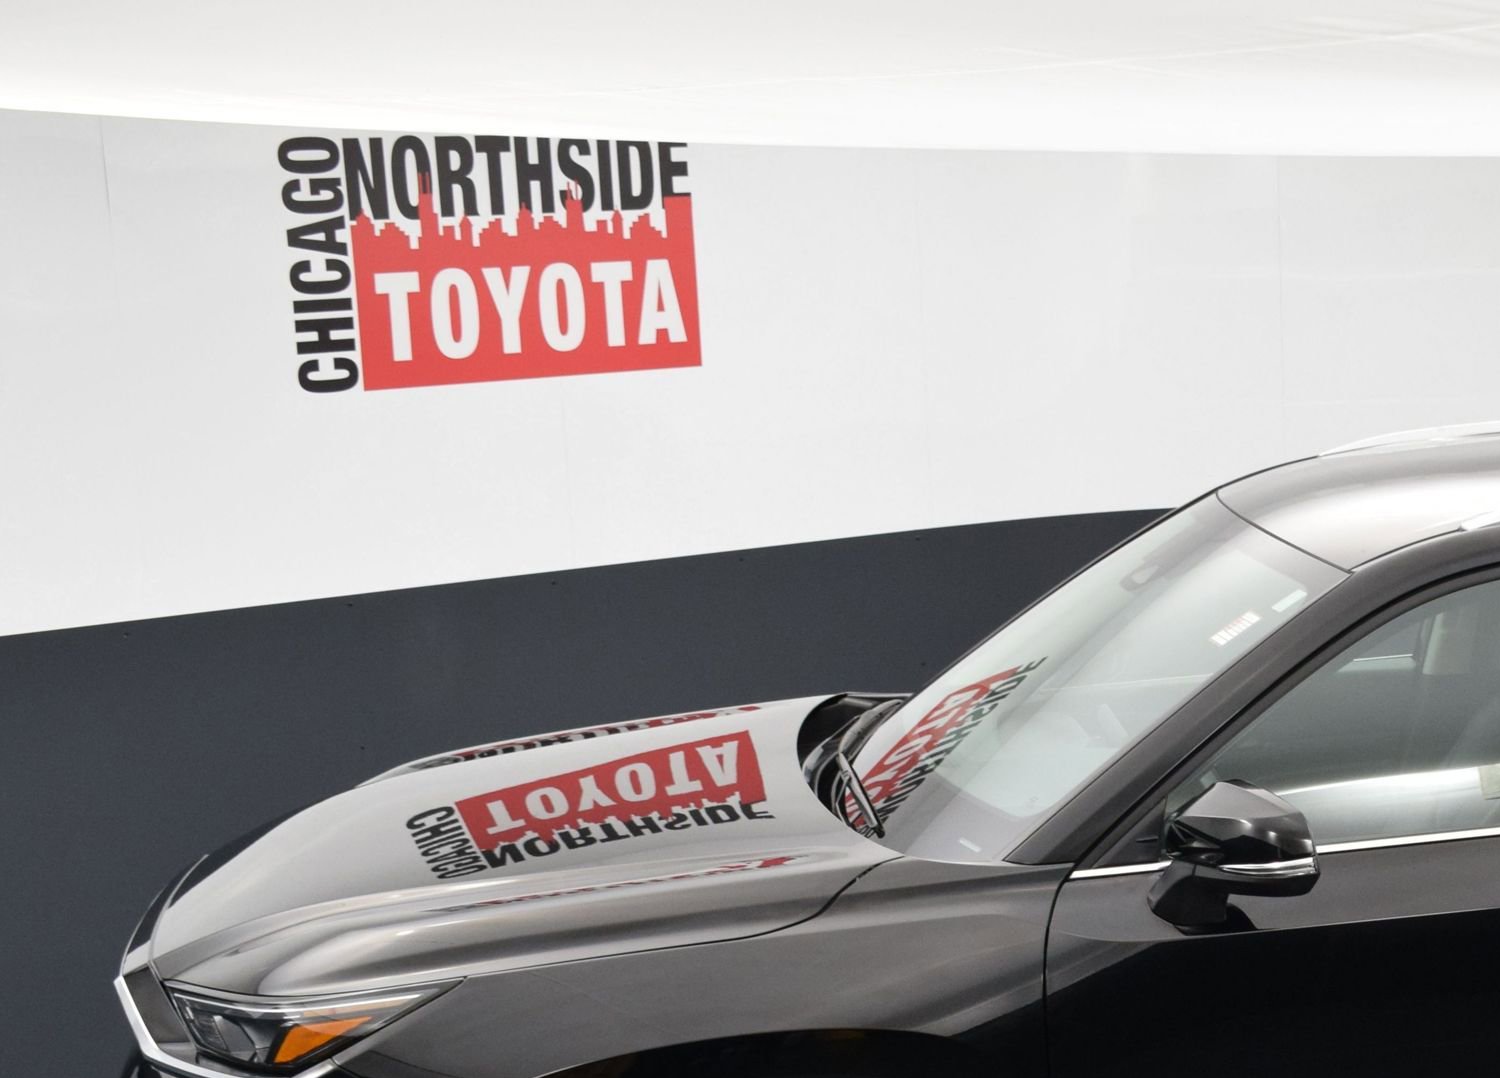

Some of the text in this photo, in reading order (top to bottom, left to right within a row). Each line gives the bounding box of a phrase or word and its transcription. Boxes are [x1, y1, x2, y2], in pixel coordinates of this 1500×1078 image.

[342, 134, 690, 222] NORTHSIDE
[278, 136, 359, 393] CHICAGO
[373, 258, 688, 361] TOYOTA
